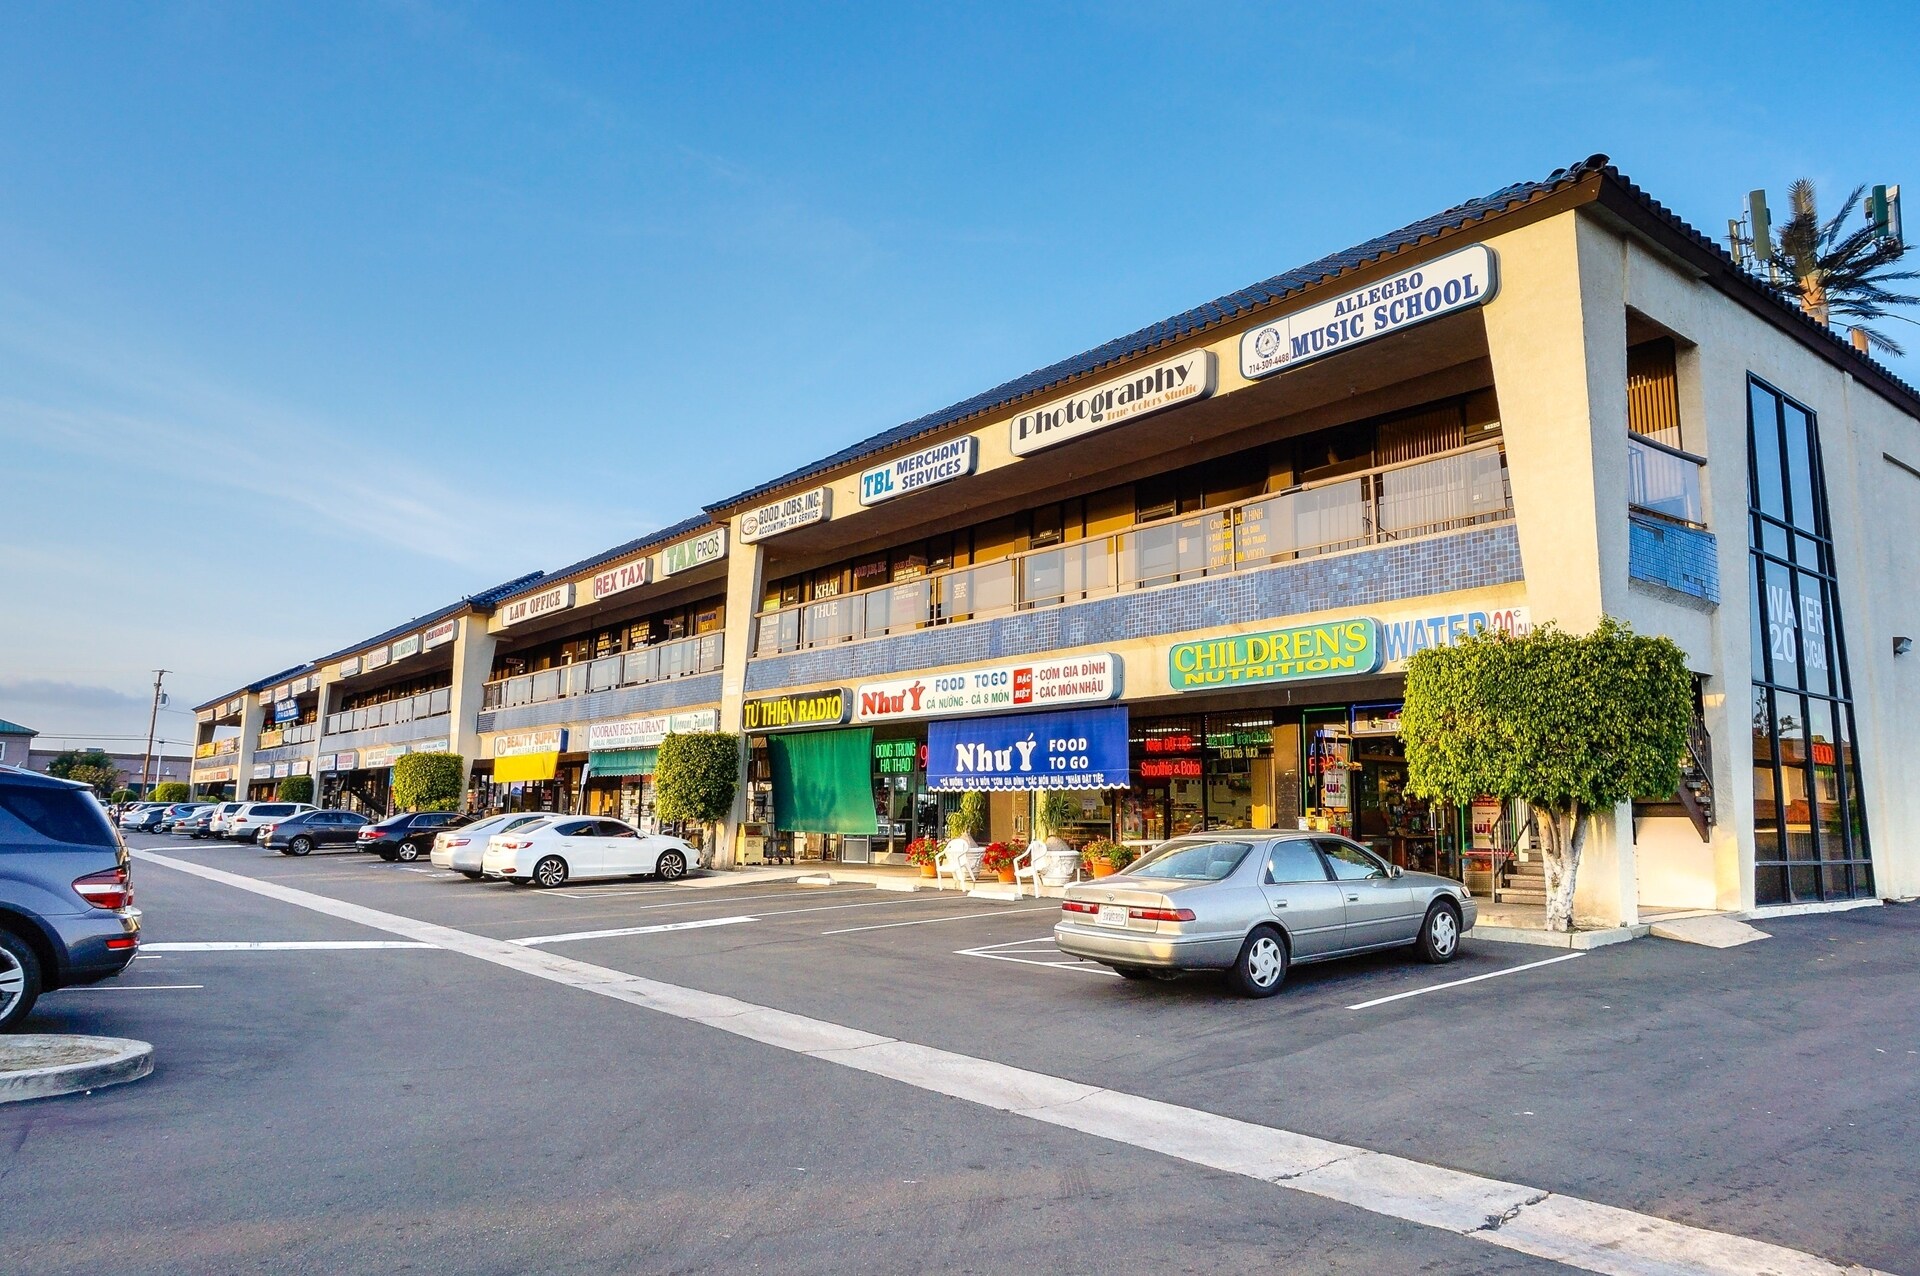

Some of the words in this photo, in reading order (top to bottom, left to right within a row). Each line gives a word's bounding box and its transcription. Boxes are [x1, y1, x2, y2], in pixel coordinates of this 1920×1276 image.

[1334, 271, 1423, 317] ALLEGRO
[1291, 313, 1364, 359] MUSIC
[1374, 273, 1479, 330] SCHOOL
[1249, 352, 1290, 374] 714-309-4488
[1019, 360, 1194, 440] Photography
[1106, 407, 1129, 421] True
[1132, 395, 1162, 412] Colors
[1164, 383, 1199, 402] Studio
[896, 439, 968, 475] MERCHANT
[863, 469, 893, 498] TBL
[902, 458, 961, 490] SERVICES
[758, 505, 779, 525] GOOD
[798, 509, 819, 523] SERVICE
[667, 540, 698, 573] TAX
[595, 571, 617, 596] REX
[620, 562, 644, 588] TAX
[815, 581, 838, 599] KHAI
[509, 602, 527, 620] LAW
[530, 590, 561, 613] OFFICE
[1174, 622, 1368, 673] CHILDREN'S
[1063, 665, 1079, 678] GIA
[1081, 660, 1106, 676] ĐÌNH
[1184, 655, 1355, 685] NUTRITION
[908, 680, 926, 711] Ý
[935, 676, 965, 692] FOOD
[991, 689, 1010, 703] MÓN
[1039, 682, 1057, 698] CÁC
[1058, 680, 1078, 696] MÓN
[1079, 677, 1104, 695] NHẬU
[761, 696, 796, 727] THIỆN
[797, 695, 842, 722] RADIO
[507, 733, 533, 748] BEAUTY
[534, 730, 560, 745] SUPPLY
[591, 724, 619, 738] NOORANI
[620, 719, 666, 736] RESTAURANT
[955, 742, 1013, 773] Như
[1015, 732, 1037, 772] Ý
[1049, 738, 1087, 752] FOOD
[1048, 756, 1066, 770] TO
[1070, 755, 1089, 769] GO
[1141, 761, 1173, 776] Smoothie
[1173, 764, 1181, 774] &
[1181, 760, 1201, 775] Boba
[1474, 818, 1491, 833] wi
